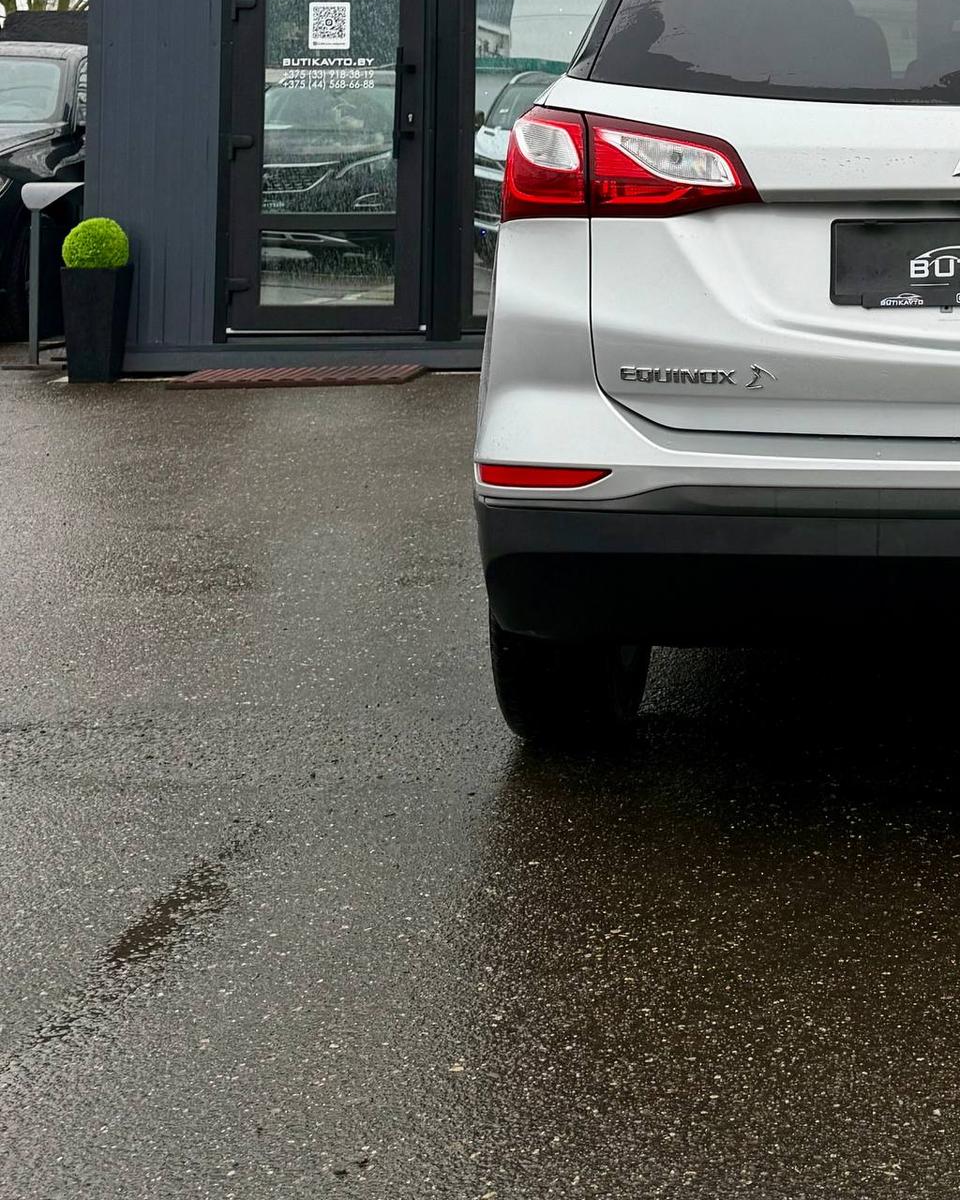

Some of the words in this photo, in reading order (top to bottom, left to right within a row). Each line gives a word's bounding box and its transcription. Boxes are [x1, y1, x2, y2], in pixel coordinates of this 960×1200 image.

[282, 57, 375, 67] BUTIKAVTO.BY
[282, 69, 306, 79] +375
[308, 69, 326, 80] (33)
[329, 69, 375, 79] 918-38-19
[282, 79, 306, 89] +375
[308, 79, 326, 90] (44)
[329, 79, 375, 89] 568-66-88
[620, 365, 737, 385] EQUINOX
